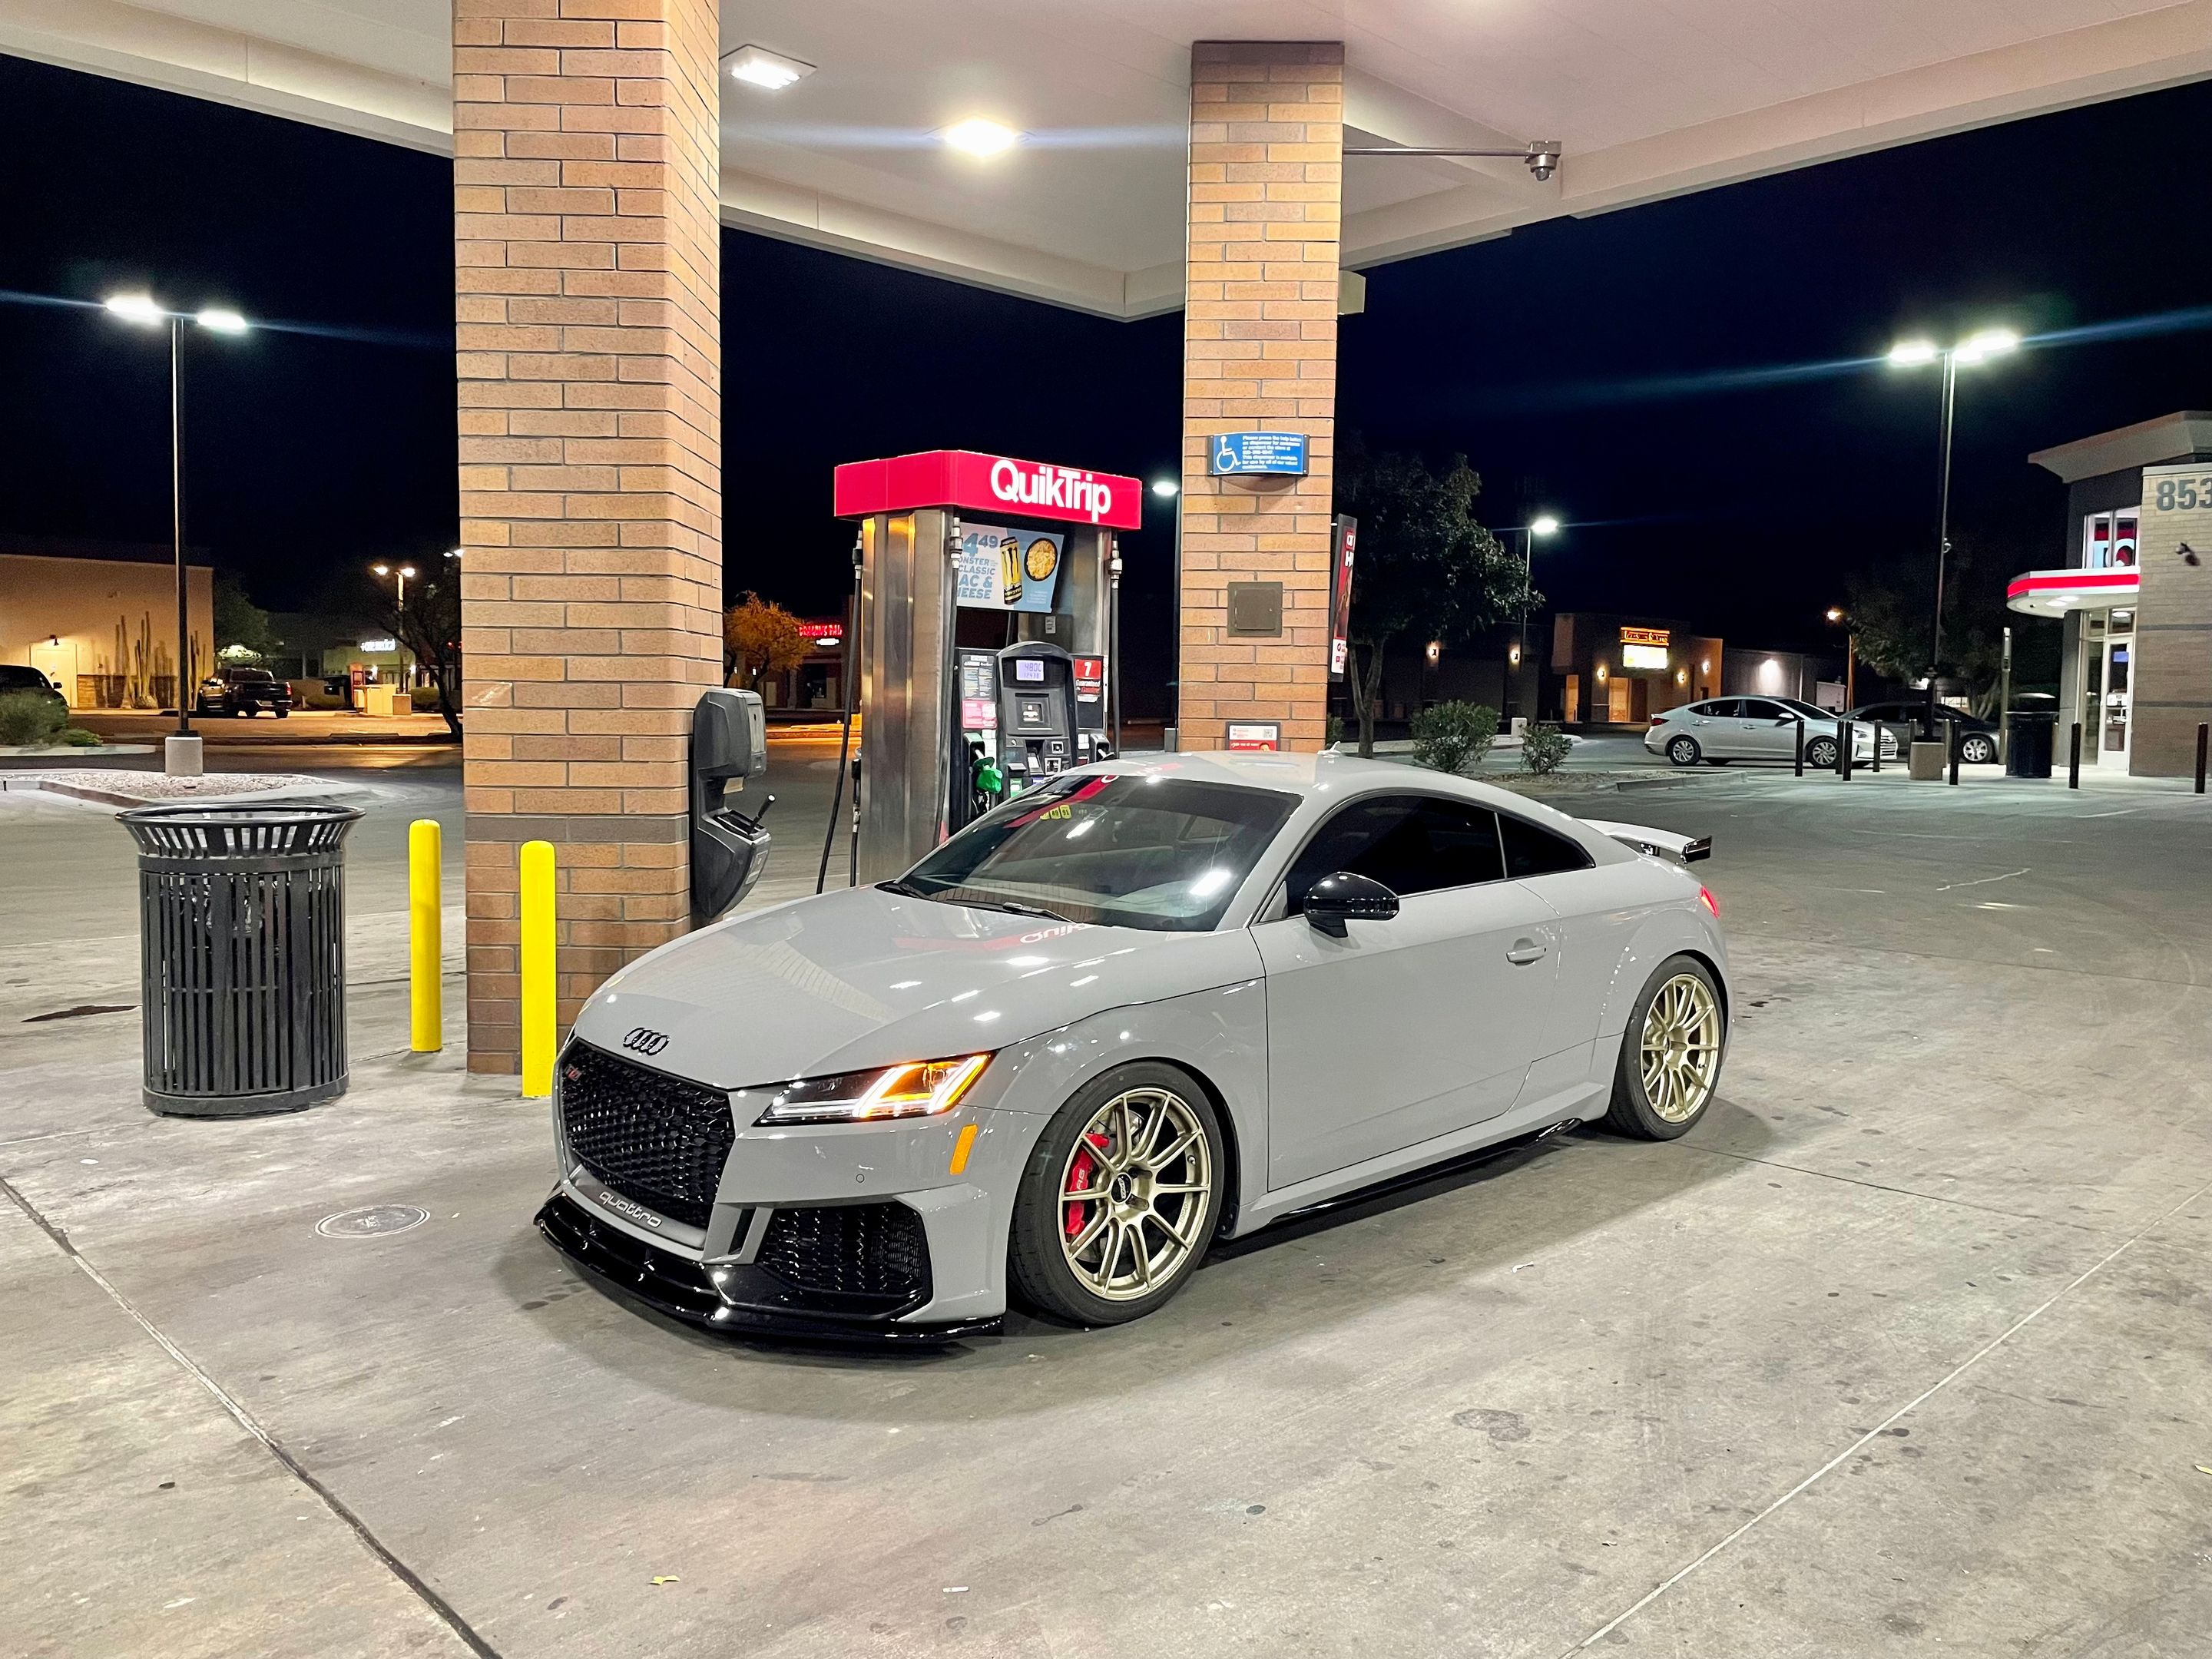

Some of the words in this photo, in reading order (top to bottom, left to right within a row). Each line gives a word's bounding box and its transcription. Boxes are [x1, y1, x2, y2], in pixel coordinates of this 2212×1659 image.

[990, 459, 1111, 523] QuikTrip
[959, 556, 990, 567] ONSTER
[959, 575, 980, 588] AC
[958, 588, 992, 599] EESE
[1084, 661, 1092, 677] 7
[1077, 1169, 1085, 1190] RS
[599, 1191, 662, 1227] quattro
